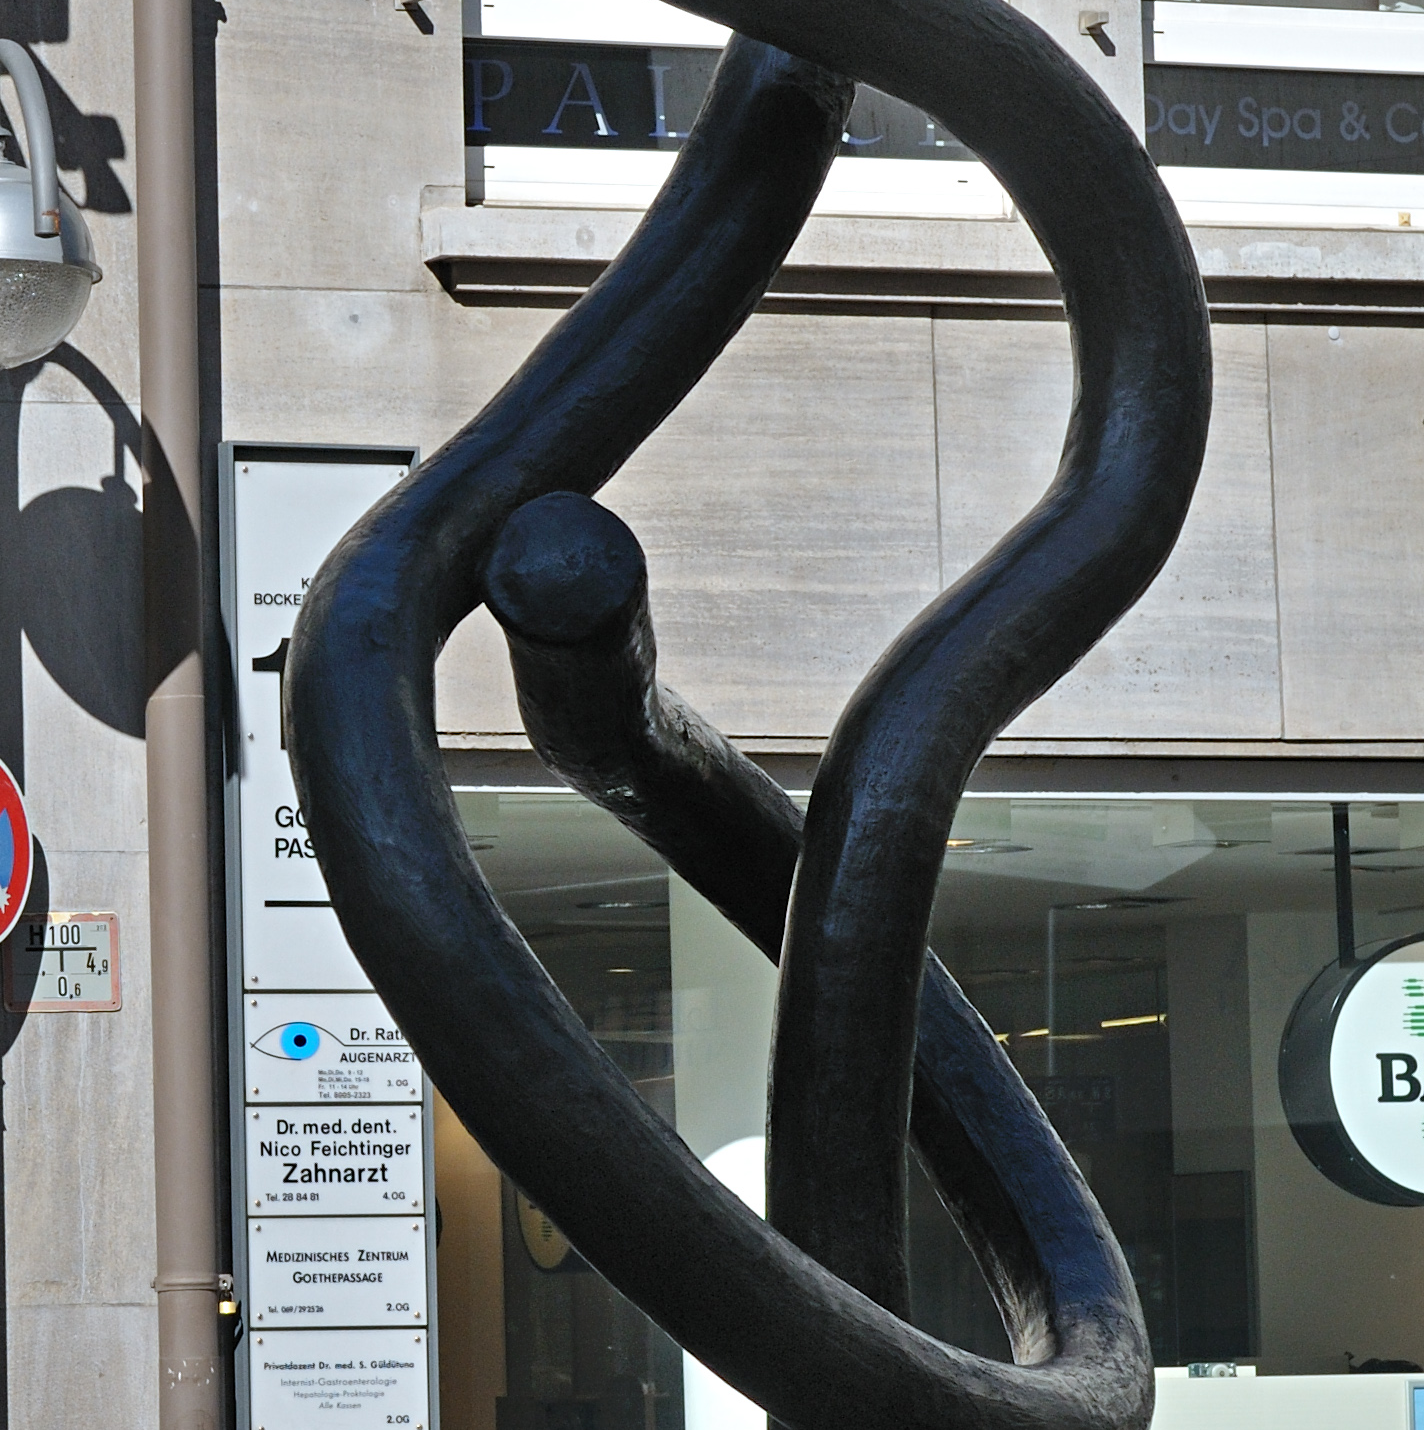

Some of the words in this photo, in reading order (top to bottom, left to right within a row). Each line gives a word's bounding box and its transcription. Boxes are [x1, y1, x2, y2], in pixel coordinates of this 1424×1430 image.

[1238, 96, 1322, 147] Spa
[1340, 100, 1371, 141] &
[254, 593, 306, 606] BOCKE
[350, 1027, 370, 1041] Dr.
[339, 1051, 416, 1063] AUGENARZT
[396, 1079, 409, 1087] OG
[276, 1120, 299, 1135] Dr.
[303, 1119, 347, 1134] med.
[351, 1119, 397, 1134] dent.
[260, 1141, 301, 1156] Nico
[311, 1140, 411, 1158] Feichtinger
[282, 1163, 388, 1183] Zahnarzt
[265, 1193, 279, 1202] Tel.
[266, 1250, 350, 1263] MEDIZINISCHES
[357, 1249, 409, 1261] ZENTRUM
[292, 1271, 383, 1284] GOETHEPASSAGE
